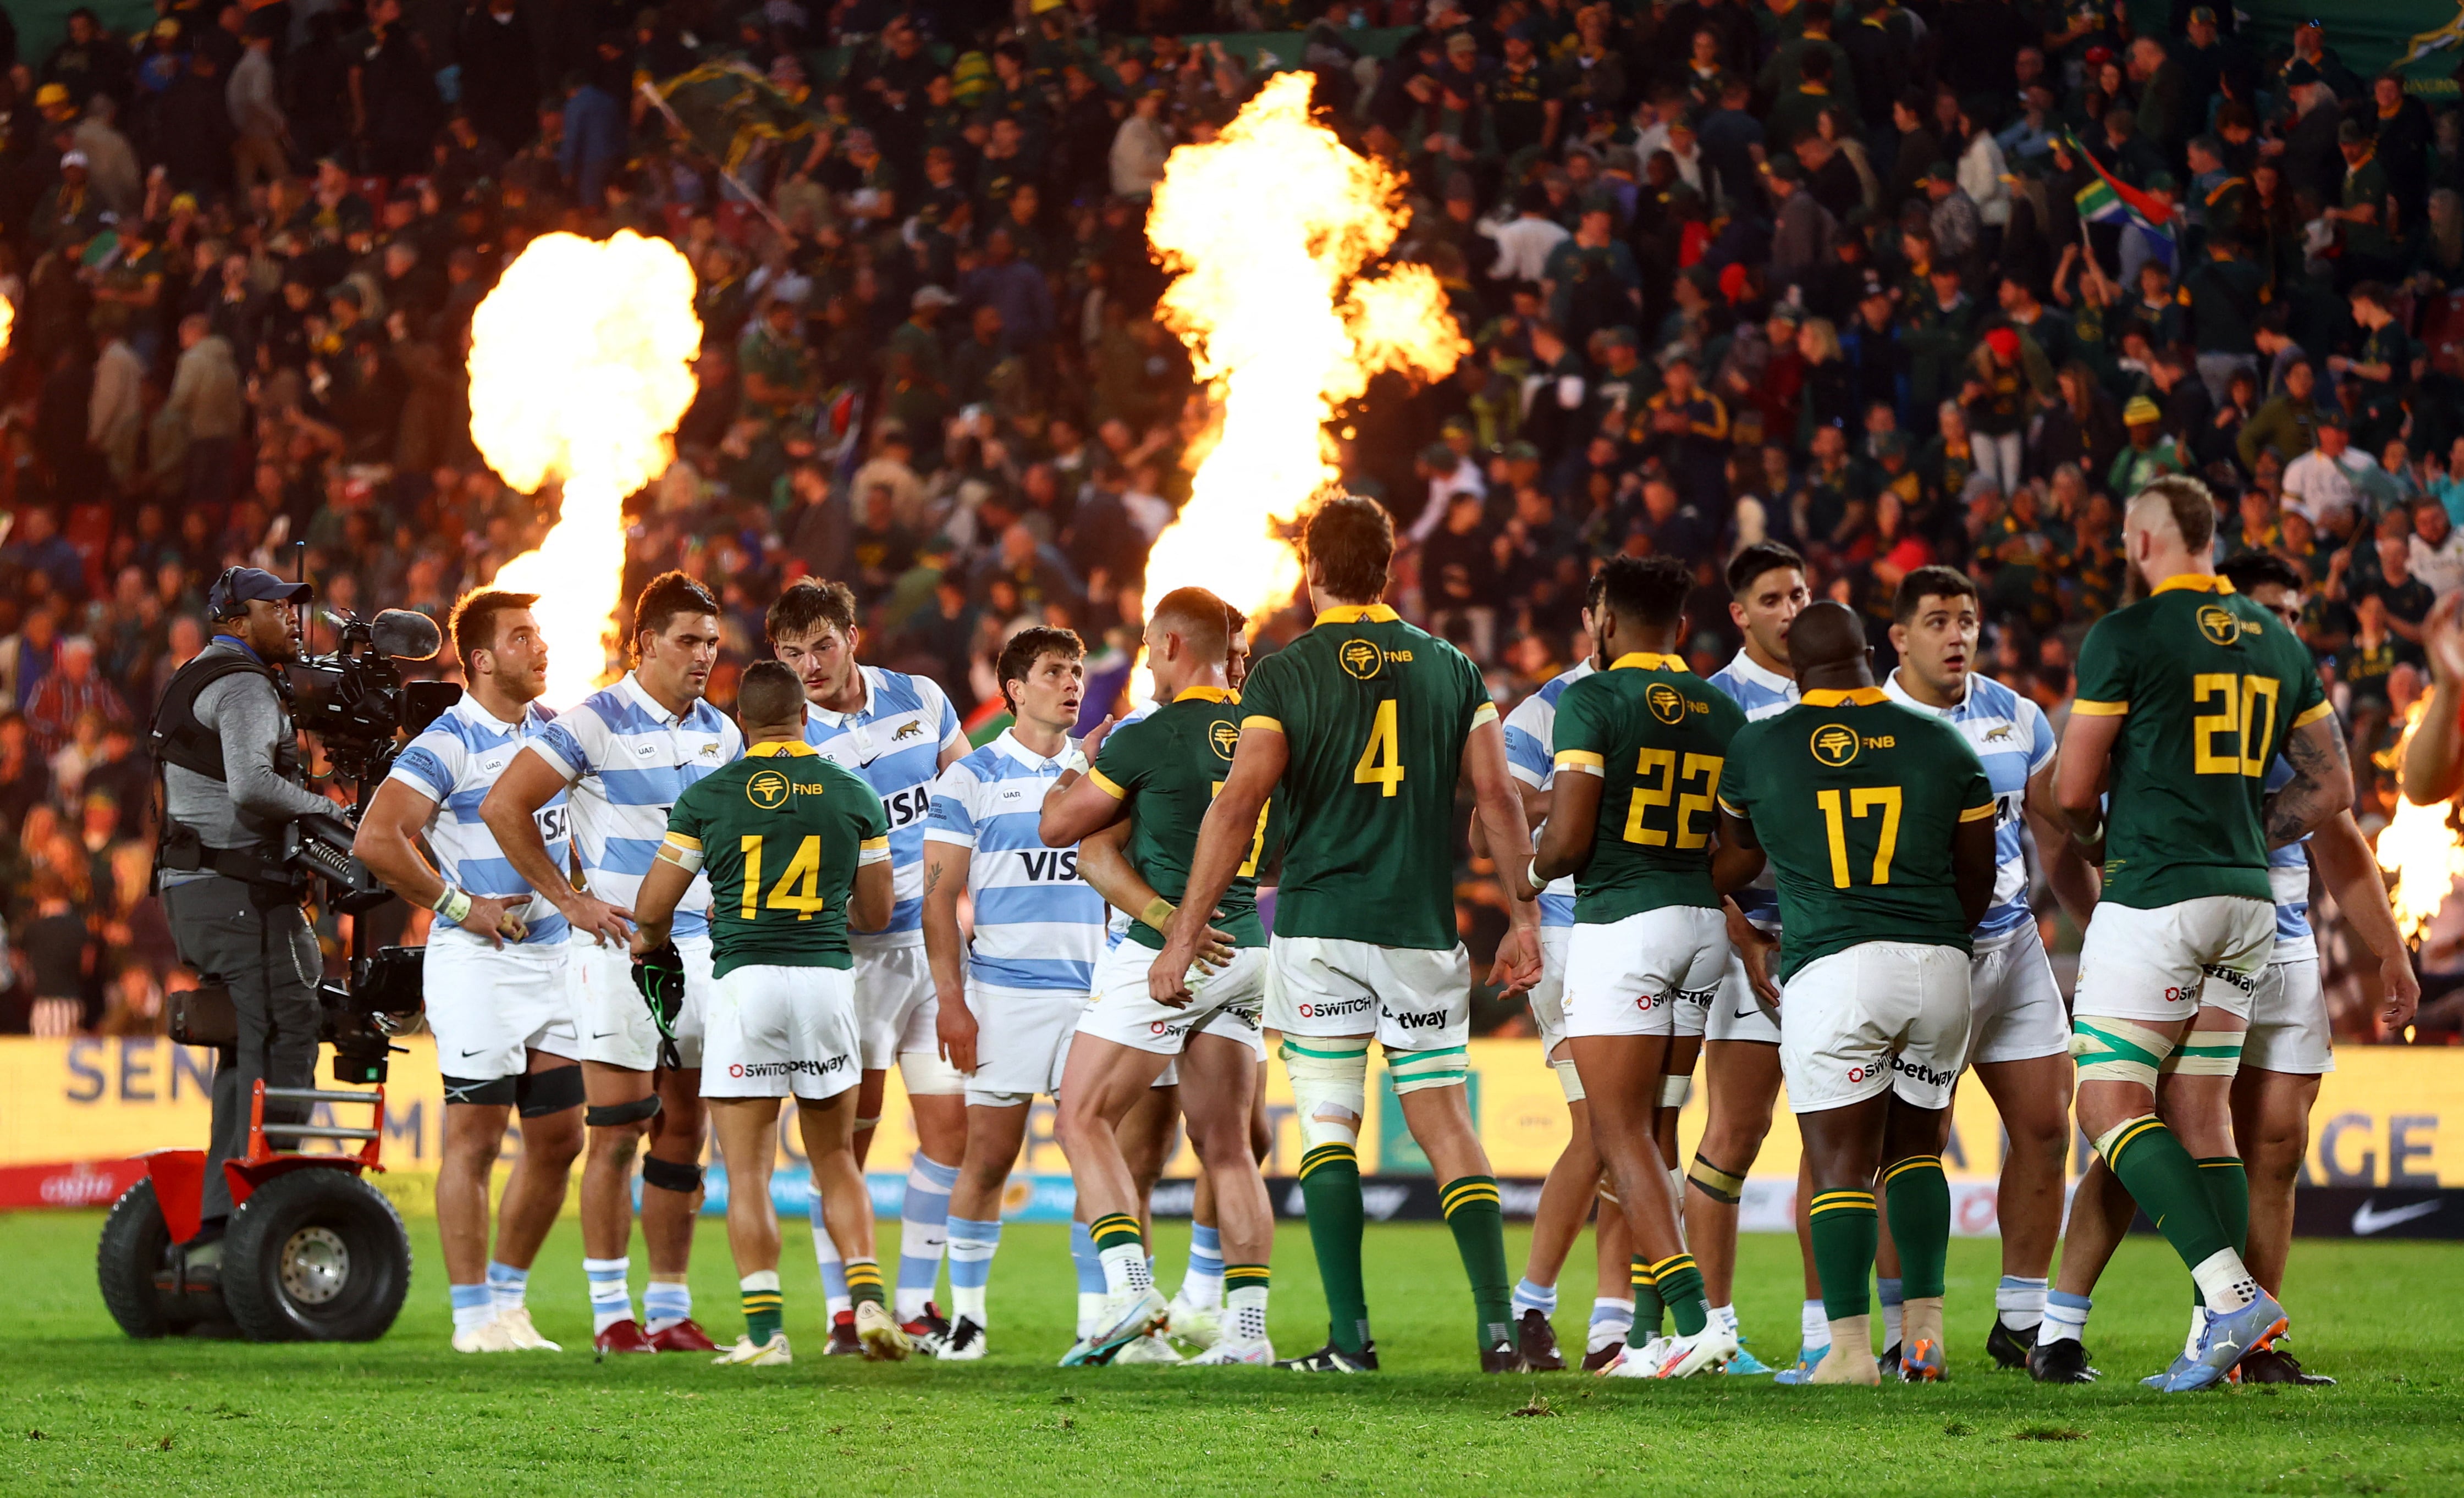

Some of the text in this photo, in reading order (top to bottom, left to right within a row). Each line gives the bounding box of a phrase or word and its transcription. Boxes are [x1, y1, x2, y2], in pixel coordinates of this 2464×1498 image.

[1382, 650, 1413, 663] FNB
[2193, 672, 2280, 778] 20
[484, 760, 501, 770] UAR
[1353, 698, 1404, 798] 4
[792, 782, 823, 795] FNB
[883, 787, 929, 828] ISA
[1623, 747, 1724, 849] 22
[1816, 786, 1902, 889] 17
[741, 834, 824, 921] 14
[1015, 851, 1083, 881] VIS
[1314, 996, 1371, 1017] SWITCH
[1890, 1053, 1956, 1088] betway
